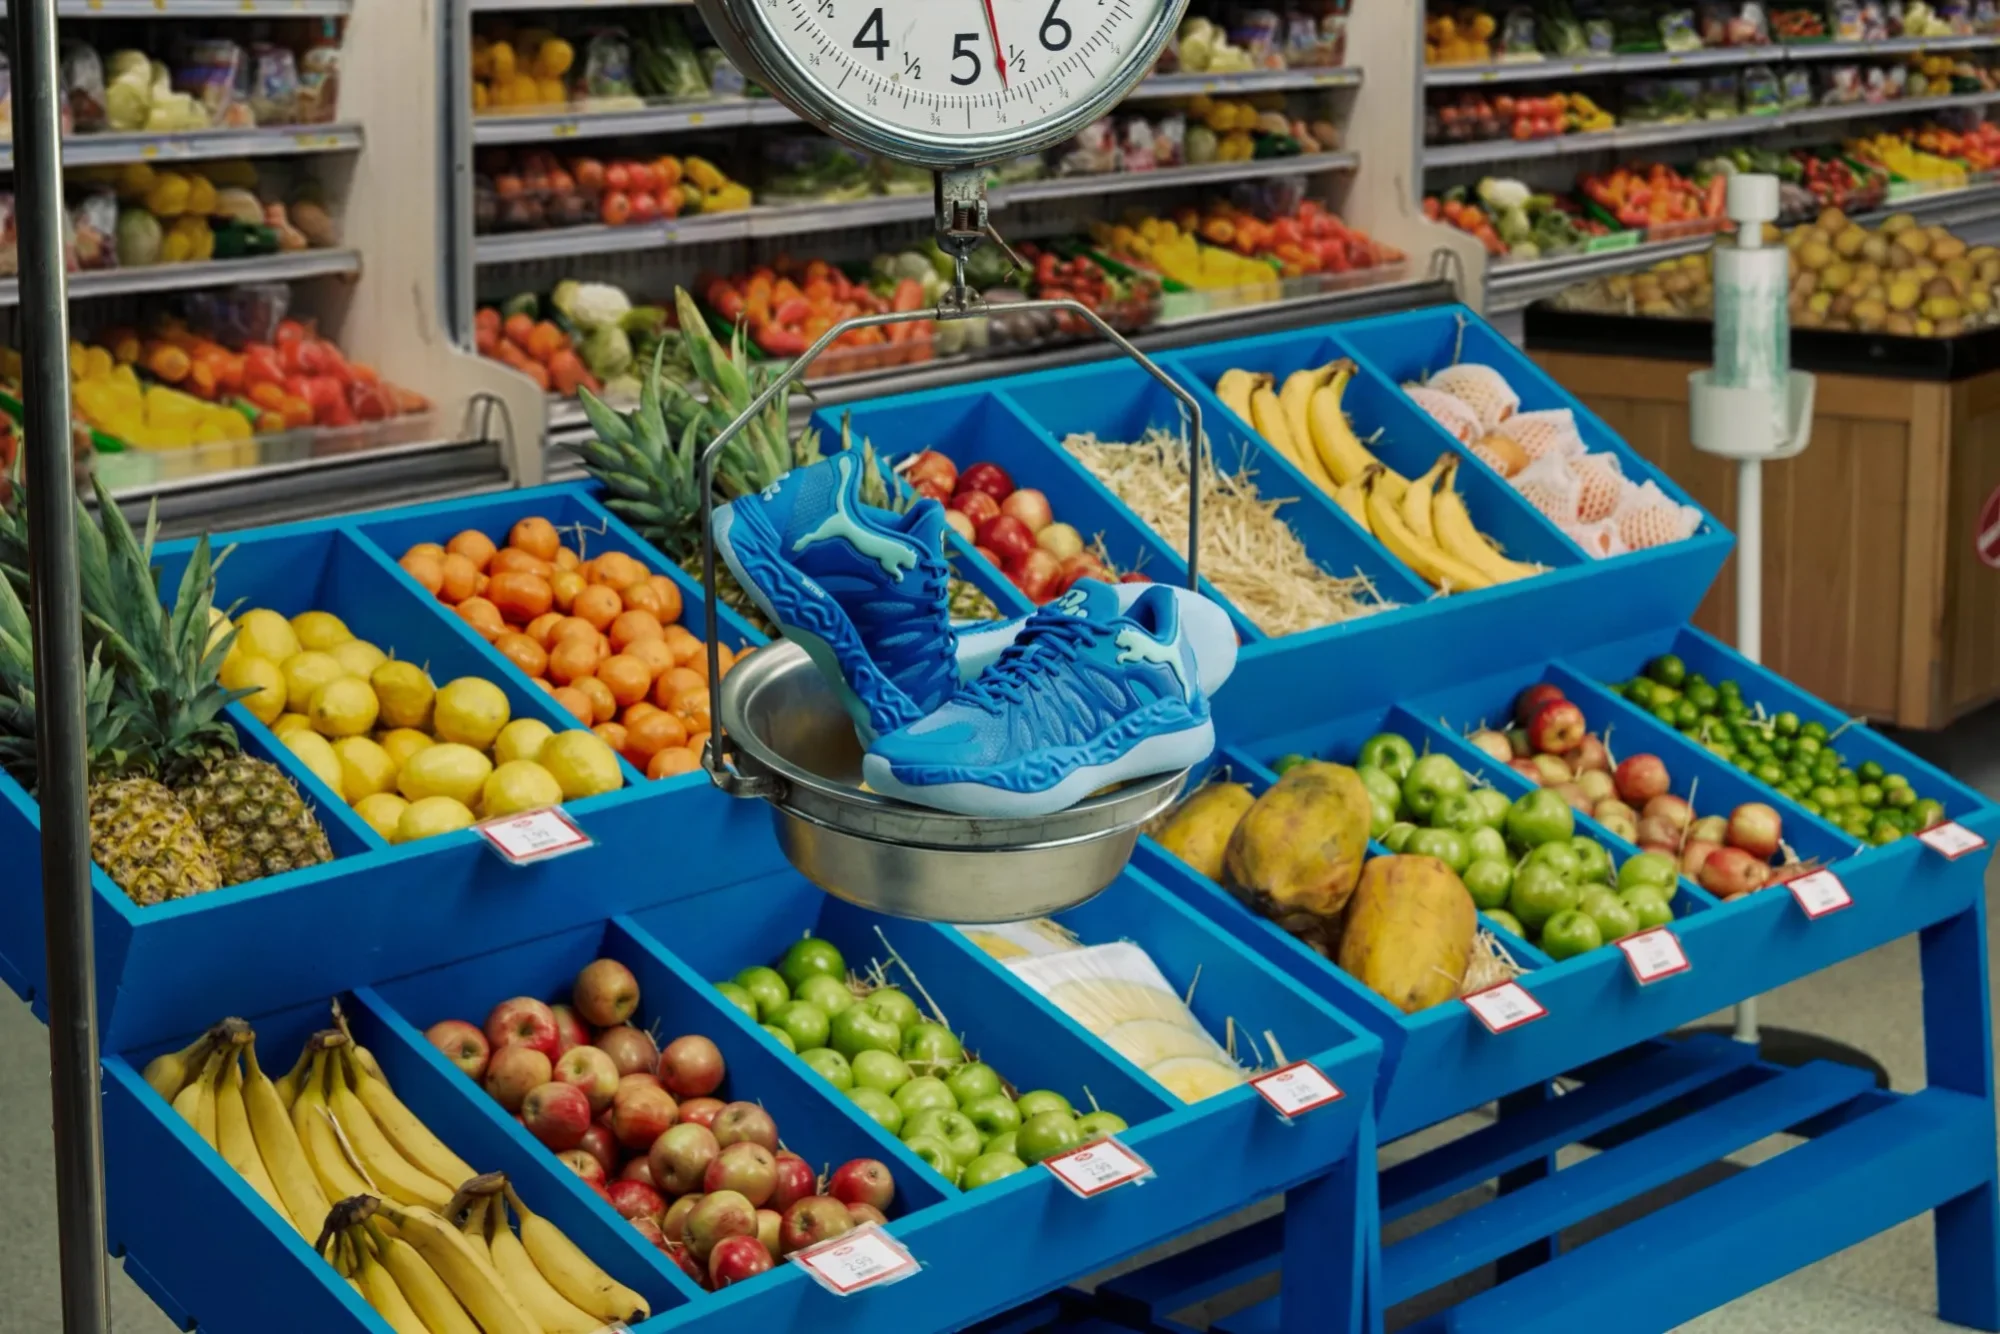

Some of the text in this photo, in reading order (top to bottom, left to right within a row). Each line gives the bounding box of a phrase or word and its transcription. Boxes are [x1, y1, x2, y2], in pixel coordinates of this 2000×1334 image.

[852, 7, 890, 61] 4
[1039, 0, 1072, 51] 6
[903, 51, 921, 79] 1/2
[950, 33, 981, 86] 5
[1009, 44, 1026, 73] 1/2
